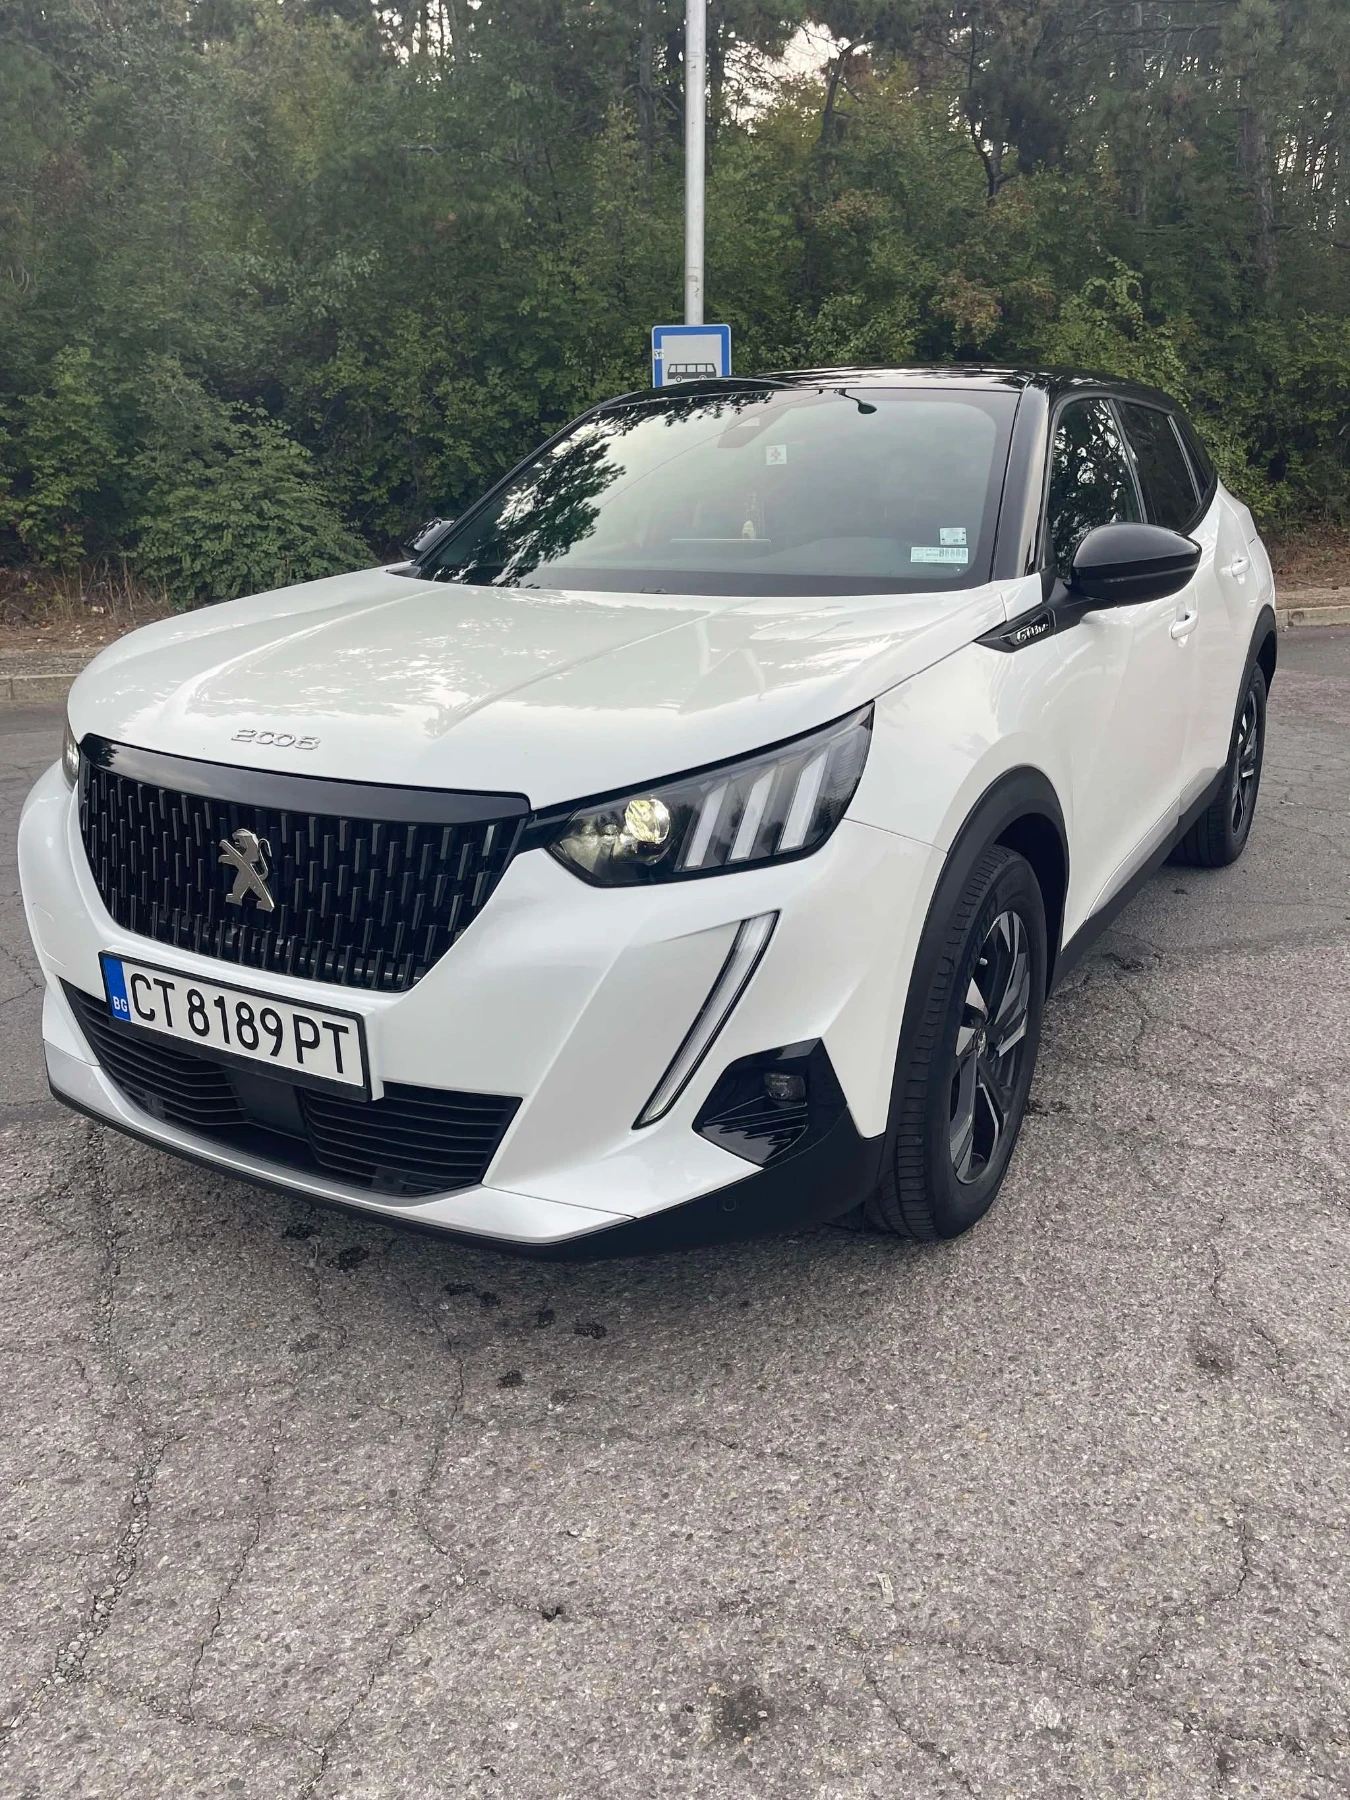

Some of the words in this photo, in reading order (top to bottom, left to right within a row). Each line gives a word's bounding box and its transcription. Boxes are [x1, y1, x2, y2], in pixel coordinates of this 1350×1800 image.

[231, 729, 321, 750] 2008
[113, 996, 128, 1012] BG
[130, 973, 175, 1028] CT
[186, 988, 284, 1057] 8189
[292, 1013, 349, 1074] PT
